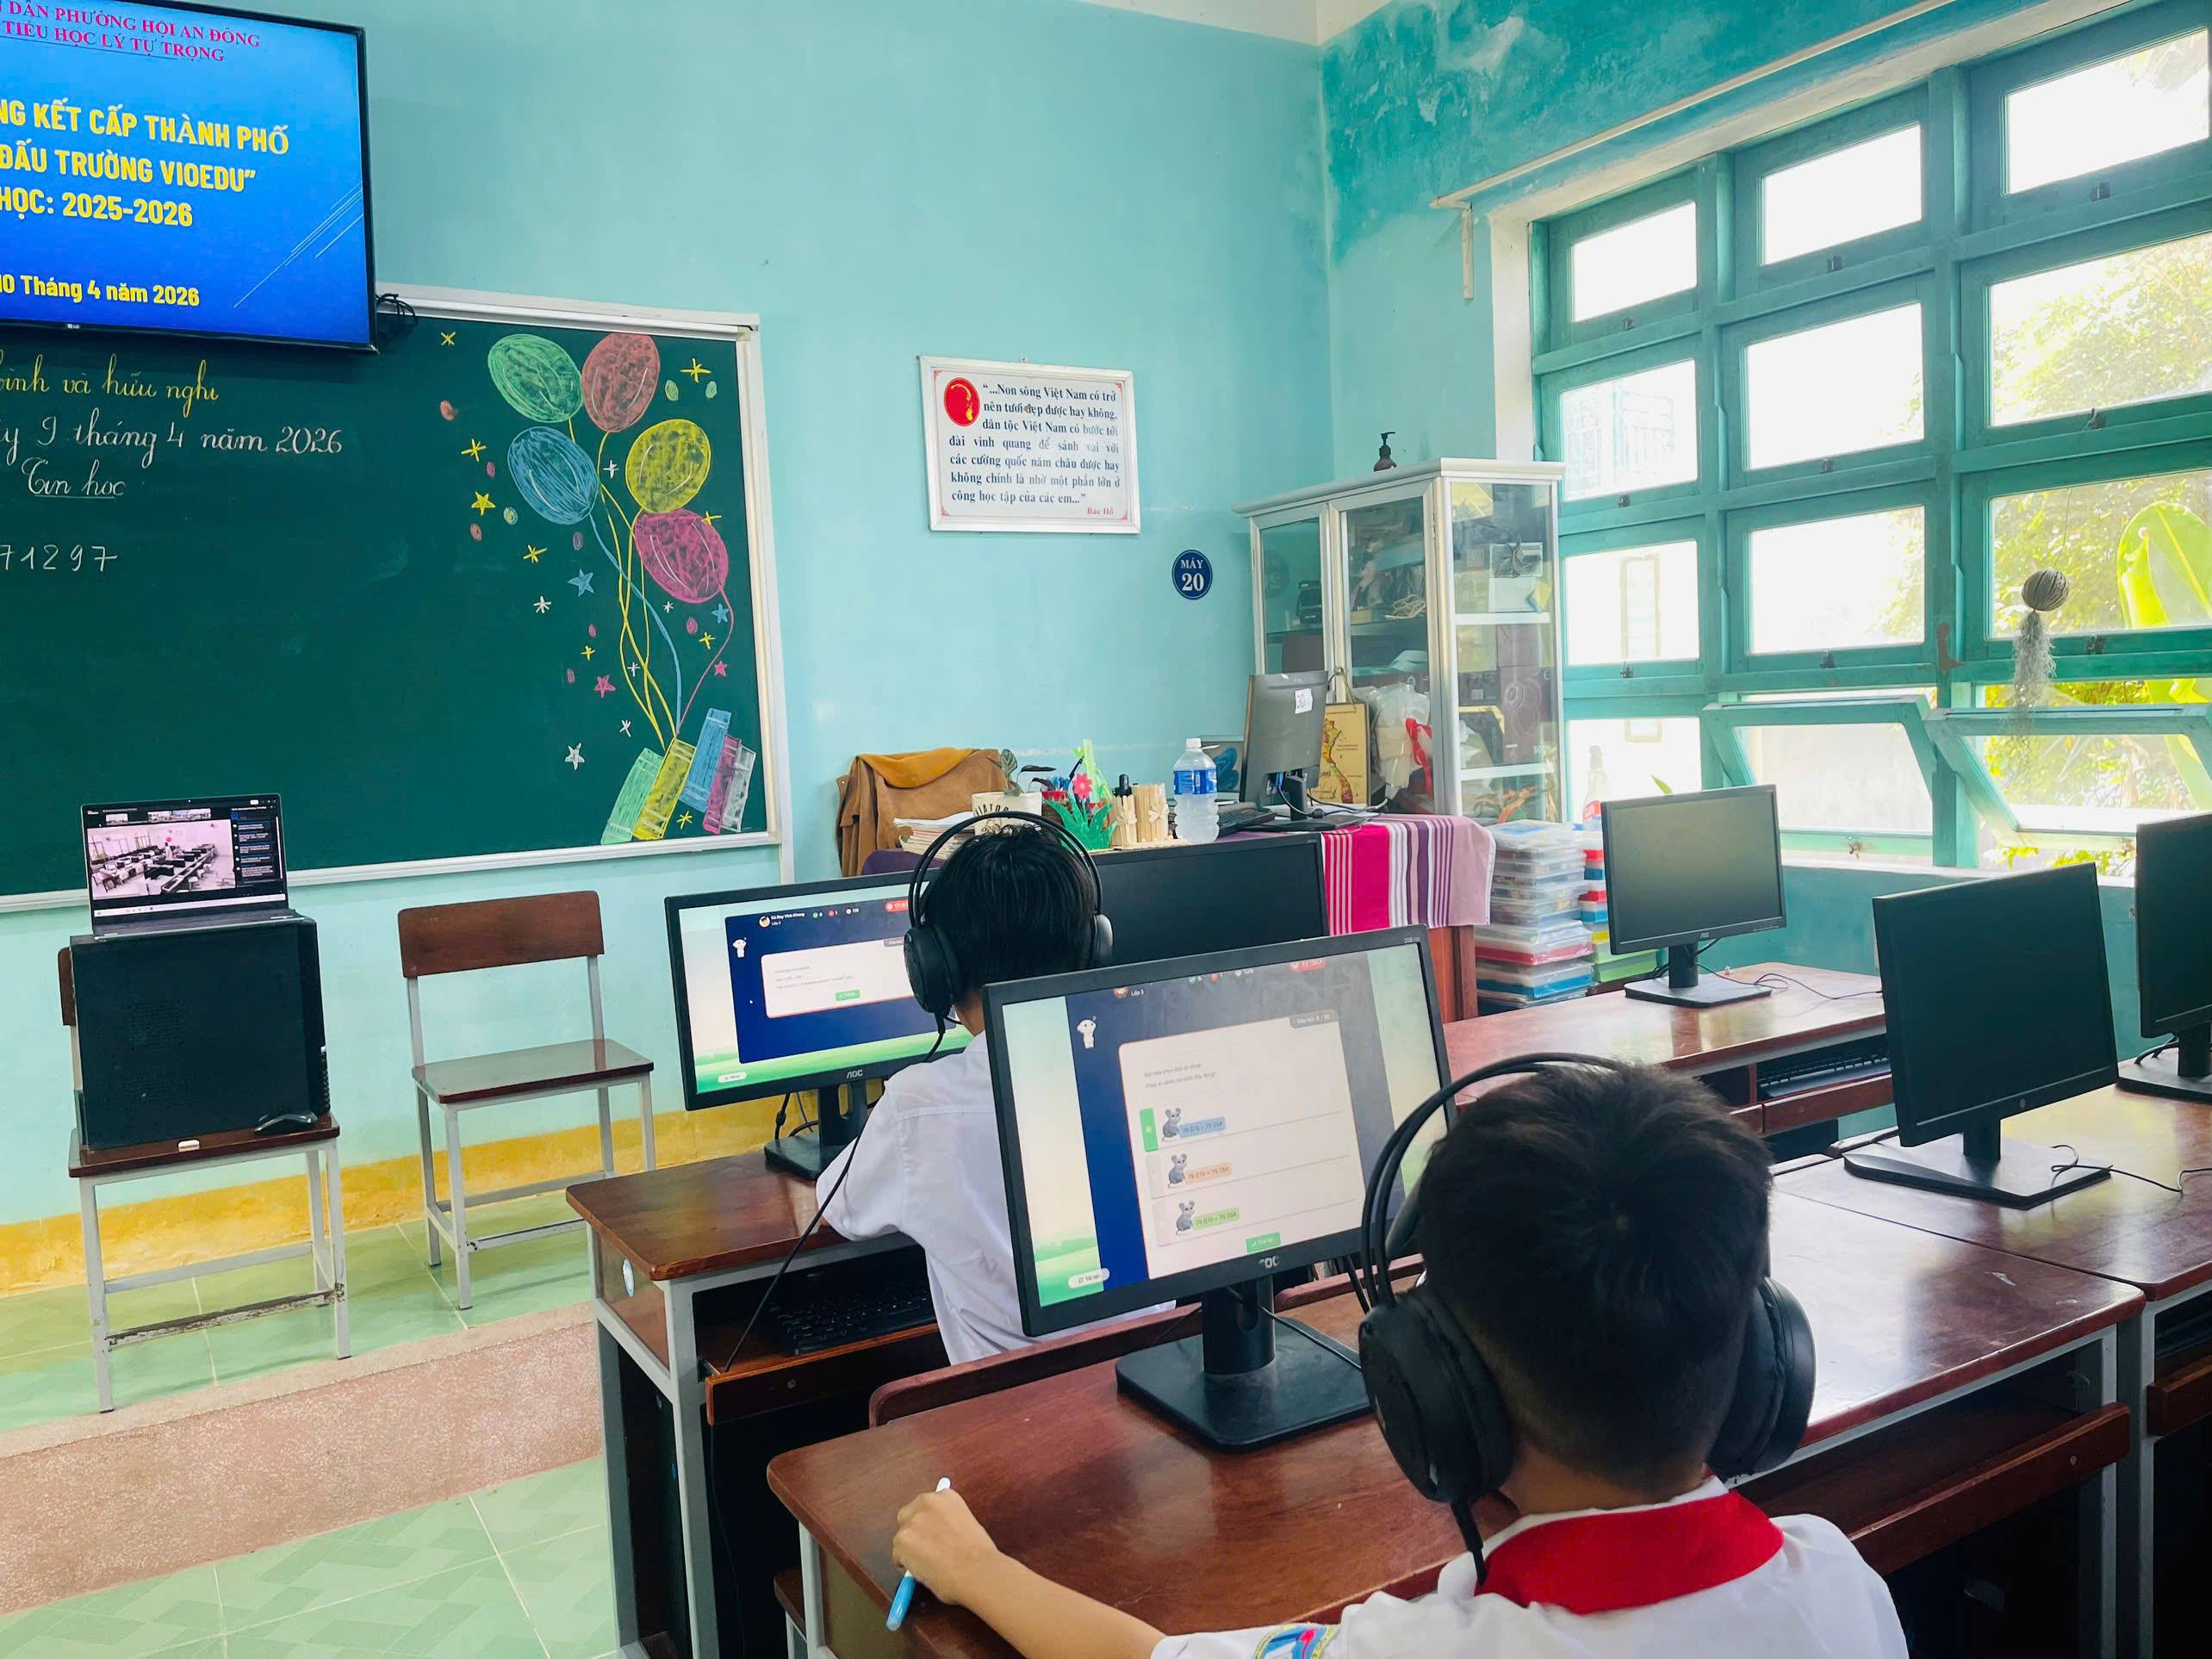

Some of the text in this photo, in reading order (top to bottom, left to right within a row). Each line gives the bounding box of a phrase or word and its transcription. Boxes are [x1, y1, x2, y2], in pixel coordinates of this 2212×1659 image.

[9, 0, 260, 47] DÂN PHƯỜNG HỘI AN ĐÔNG
[3, 20, 225, 61] TIỂU HỌC LÝ TỰ TRỌNG
[33, 97, 82, 132] KẾT
[90, 103, 138, 137] CẤP
[144, 113, 230, 149] THÀNH
[237, 125, 289, 155] PHỐ
[54, 149, 153, 183] TRƯỜNG
[0, 186, 193, 227] HỌC: 2025-2026
[20, 275, 83, 303] Tháng
[87, 280, 102, 299] 4
[106, 283, 148, 302] năm
[152, 285, 200, 307] 2026
[63, 372, 91, 395] và
[1020, 387, 1041, 399] sông
[1044, 387, 1063, 400] Việt
[1066, 388, 1087, 400] Nam
[1090, 390, 1100, 400] có
[1103, 390, 1116, 401] trở
[984, 401, 1002, 412] nên
[1004, 403, 1023, 413] tươi
[1046, 405, 1067, 417] được
[1070, 406, 1085, 419] hay
[983, 419, 1001, 430] dân
[1003, 420, 1019, 432] tộc
[1022, 420, 1041, 433] Việt
[1046, 421, 1066, 433] Nam
[1070, 423, 1079, 433] có
[1083, 424, 1103, 435] bước
[73, 407, 157, 468] tháng
[166, 422, 183, 448] 4
[201, 428, 267, 452] năm
[275, 426, 343, 454] 2026
[949, 435, 965, 446] đài
[974, 436, 995, 447] vinh
[1003, 440, 1032, 450] quang
[1058, 439, 1078, 450] sánh
[1107, 443, 1119, 453] với
[950, 453, 1119, 473] các cường quốc năm châu được hay
[951, 471, 982, 485] không
[985, 473, 1012, 483] chính
[1016, 473, 1025, 484] là
[1029, 474, 1047, 485] nhờ
[1050, 475, 1068, 487] một
[1097, 476, 1111, 488] lớn
[952, 489, 975, 503] công
[979, 490, 997, 503] học
[1000, 492, 1016, 505] tập
[1019, 491, 1035, 502] của
[1039, 492, 1055, 503] các
[1180, 557, 1203, 569] MÁY
[1182, 573, 1204, 591] 20
[847, 1070, 863, 1079] AOC
